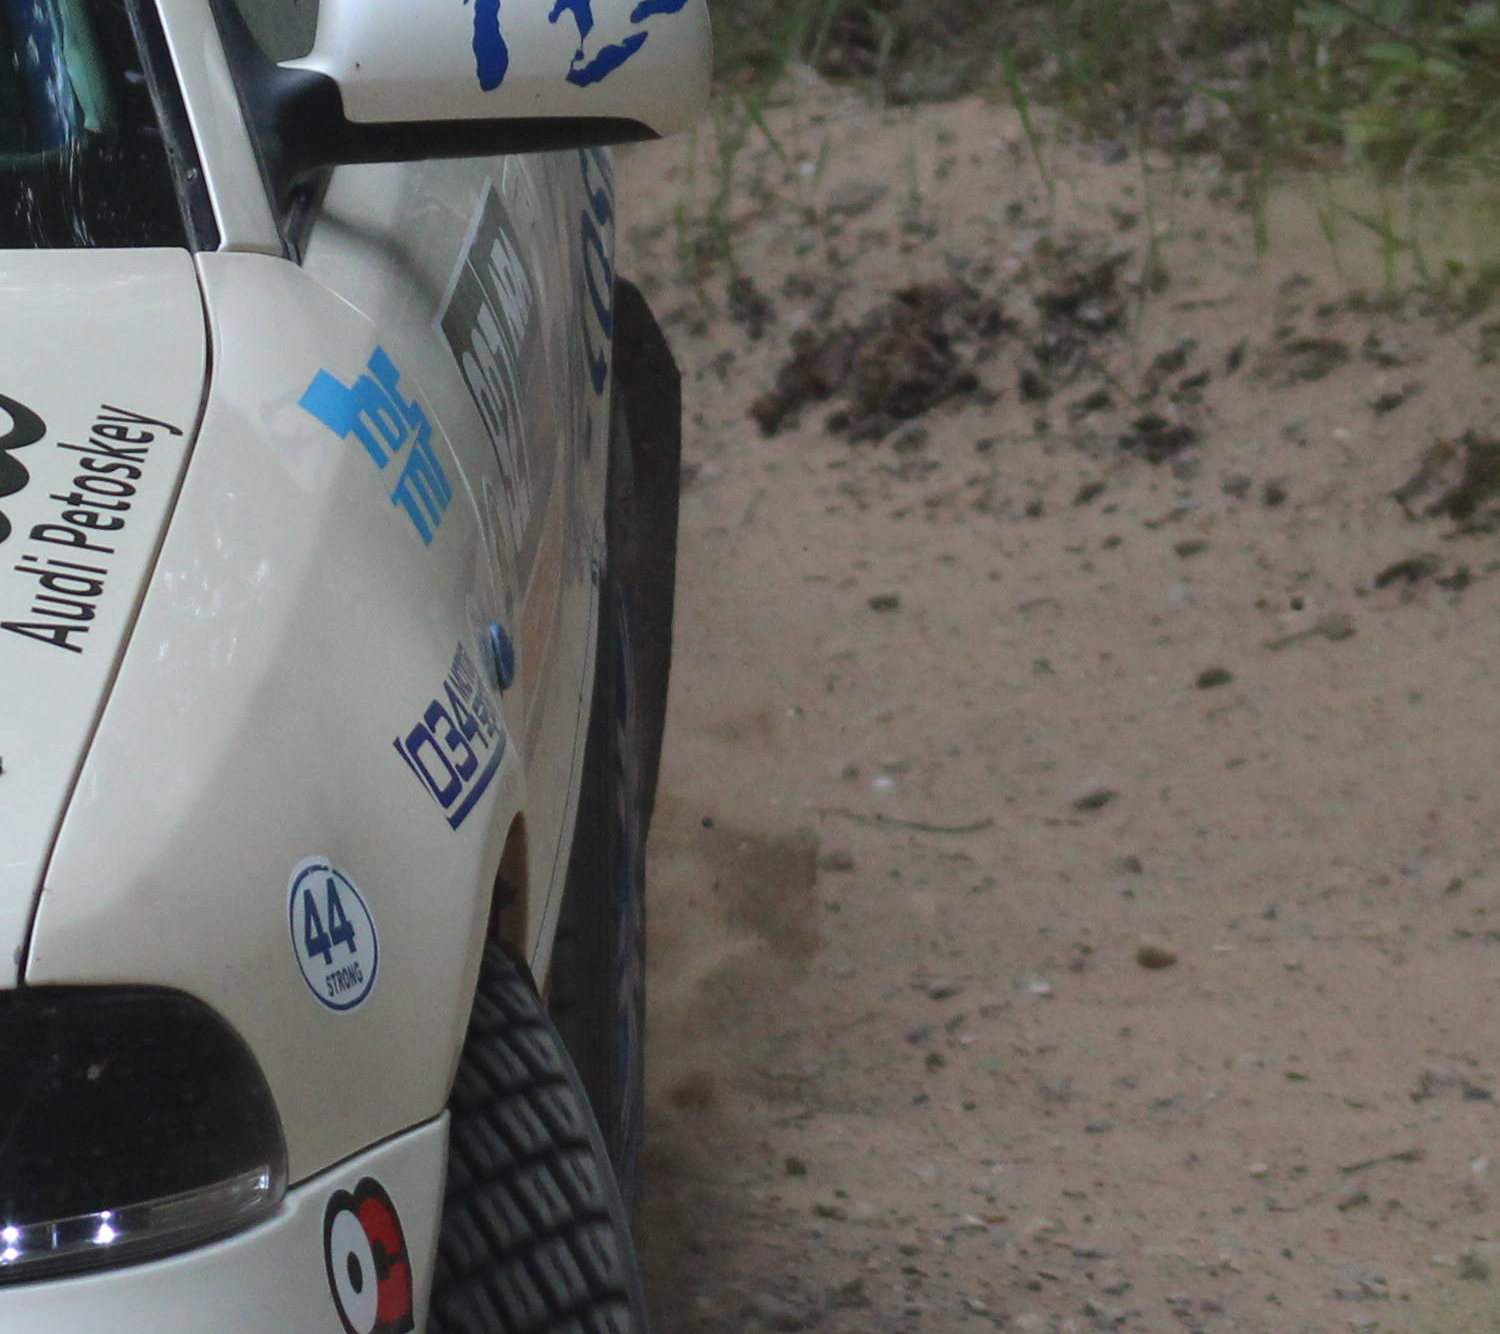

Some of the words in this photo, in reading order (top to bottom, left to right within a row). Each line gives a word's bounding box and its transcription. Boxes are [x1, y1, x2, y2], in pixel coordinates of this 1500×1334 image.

[28, 403, 184, 555] Petoskey
[0, 555, 108, 654] Audi
[303, 877, 357, 965] 44
[325, 962, 364, 998] STRONG
